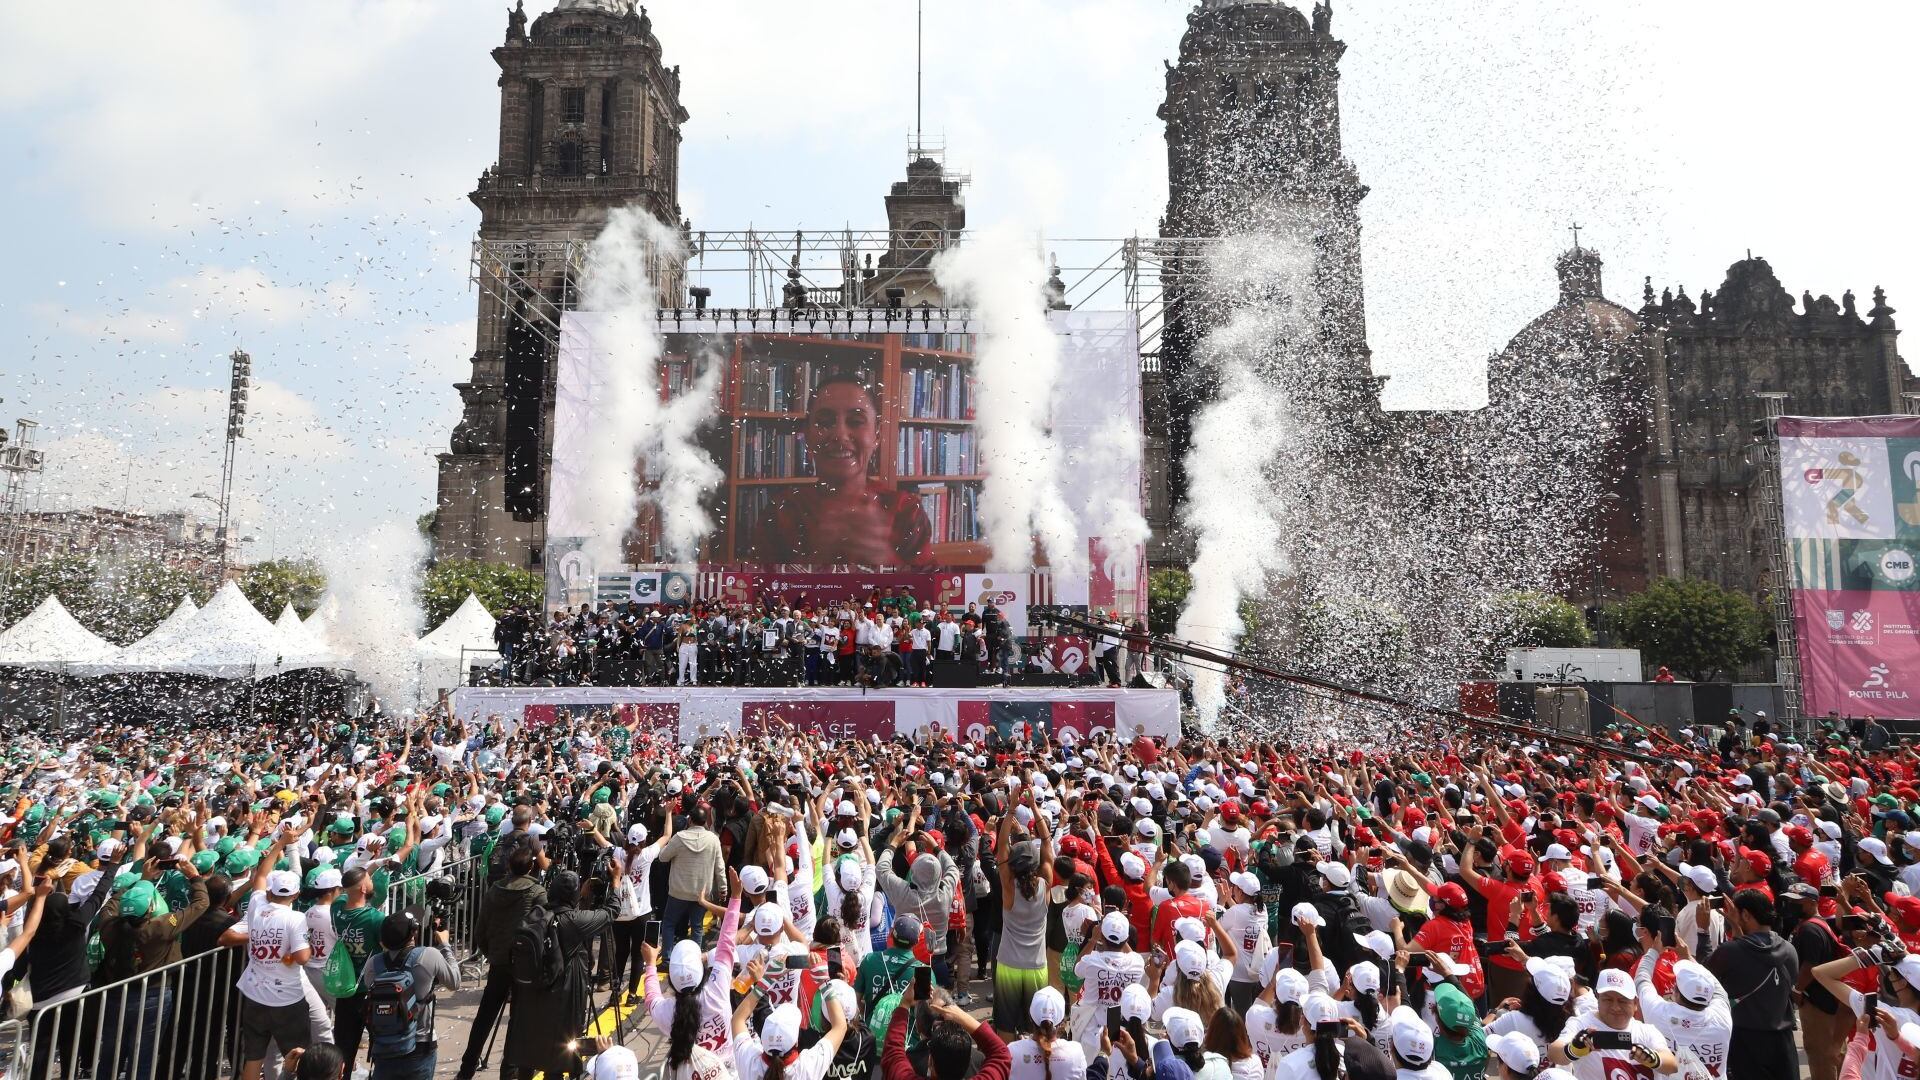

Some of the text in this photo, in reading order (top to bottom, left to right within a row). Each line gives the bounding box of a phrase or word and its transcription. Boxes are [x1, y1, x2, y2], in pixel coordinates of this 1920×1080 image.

[1885, 561, 1910, 569] CMB
[1848, 690, 1910, 699] PONTE PILA
[250, 928, 284, 940] CLASE
[1097, 969, 1139, 983] CLASE
[1606, 975, 1625, 985] BOX
[1708, 1054, 1723, 1063] DE
